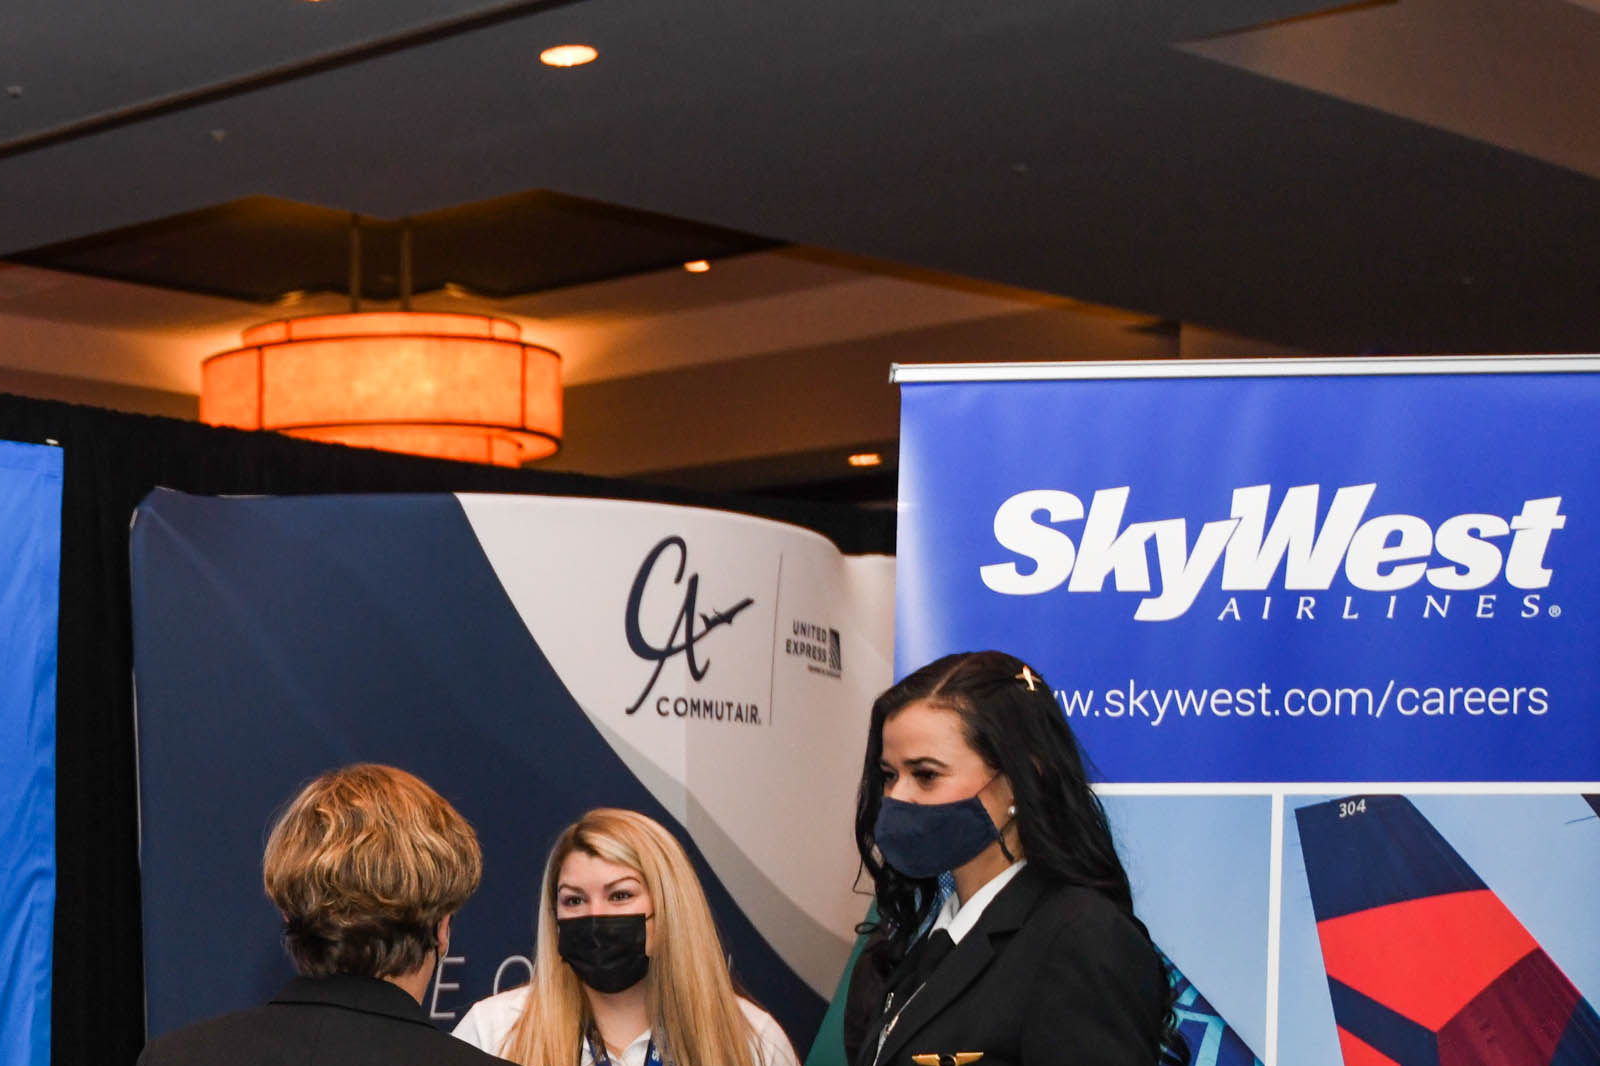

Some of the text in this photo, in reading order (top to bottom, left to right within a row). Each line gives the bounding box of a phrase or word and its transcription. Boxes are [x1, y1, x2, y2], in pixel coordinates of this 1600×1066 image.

[979, 483, 1567, 622] SkyWest
[1218, 594, 1540, 621] AIRLINES
[792, 619, 827, 643] UNITED
[785, 638, 827, 663] EXPRESS
[656, 697, 758, 724] COMMUTAIR
[1054, 679, 1548, 726] w.skywest.com/careers
[1339, 799, 1367, 818] 304
